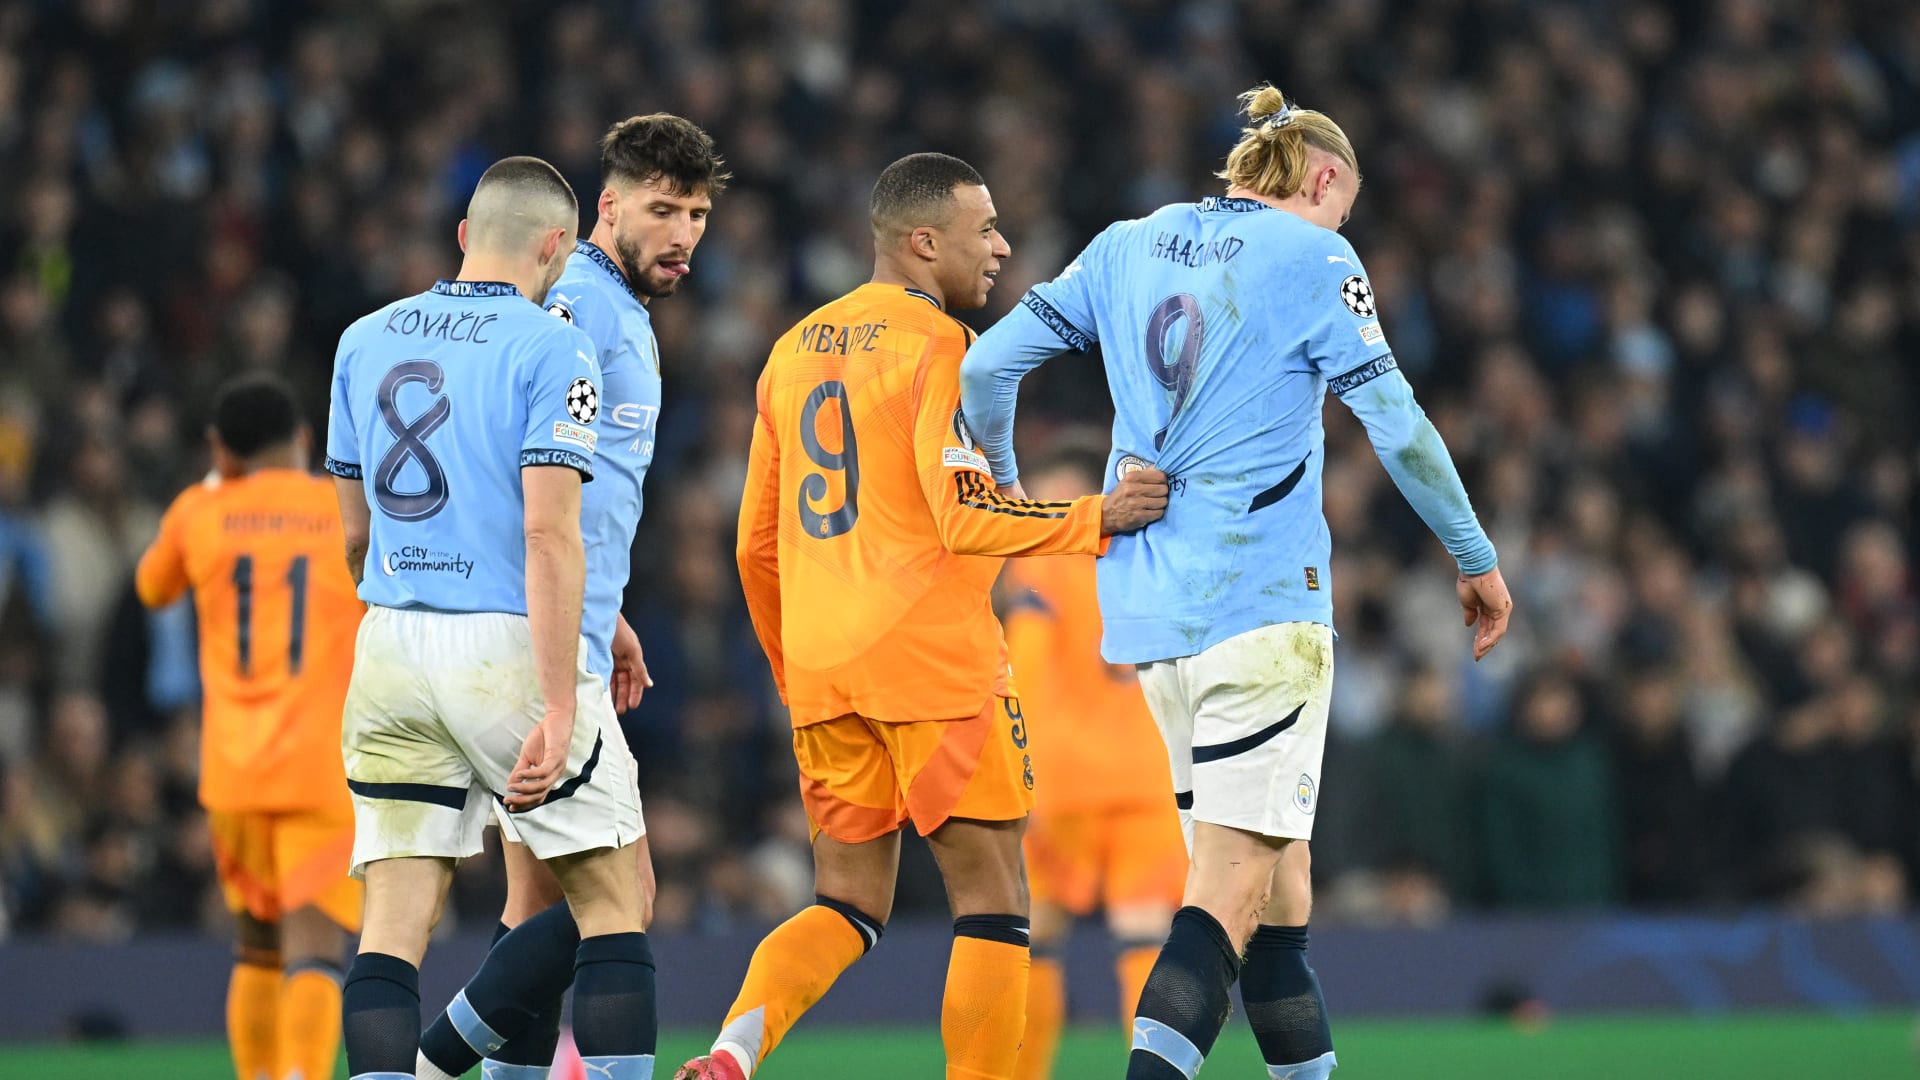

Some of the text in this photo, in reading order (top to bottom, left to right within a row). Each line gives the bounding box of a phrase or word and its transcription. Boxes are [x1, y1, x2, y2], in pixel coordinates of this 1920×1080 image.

[383, 307, 498, 344] KOVAČIĆ
[1144, 293, 1205, 453] 9
[373, 359, 451, 522] 8
[612, 402, 658, 431] ET
[798, 380, 860, 540] 9
[389, 551, 474, 580] Community
[401, 545, 428, 560] City
[231, 555, 309, 678] 11
[1004, 696, 1028, 750] 9
